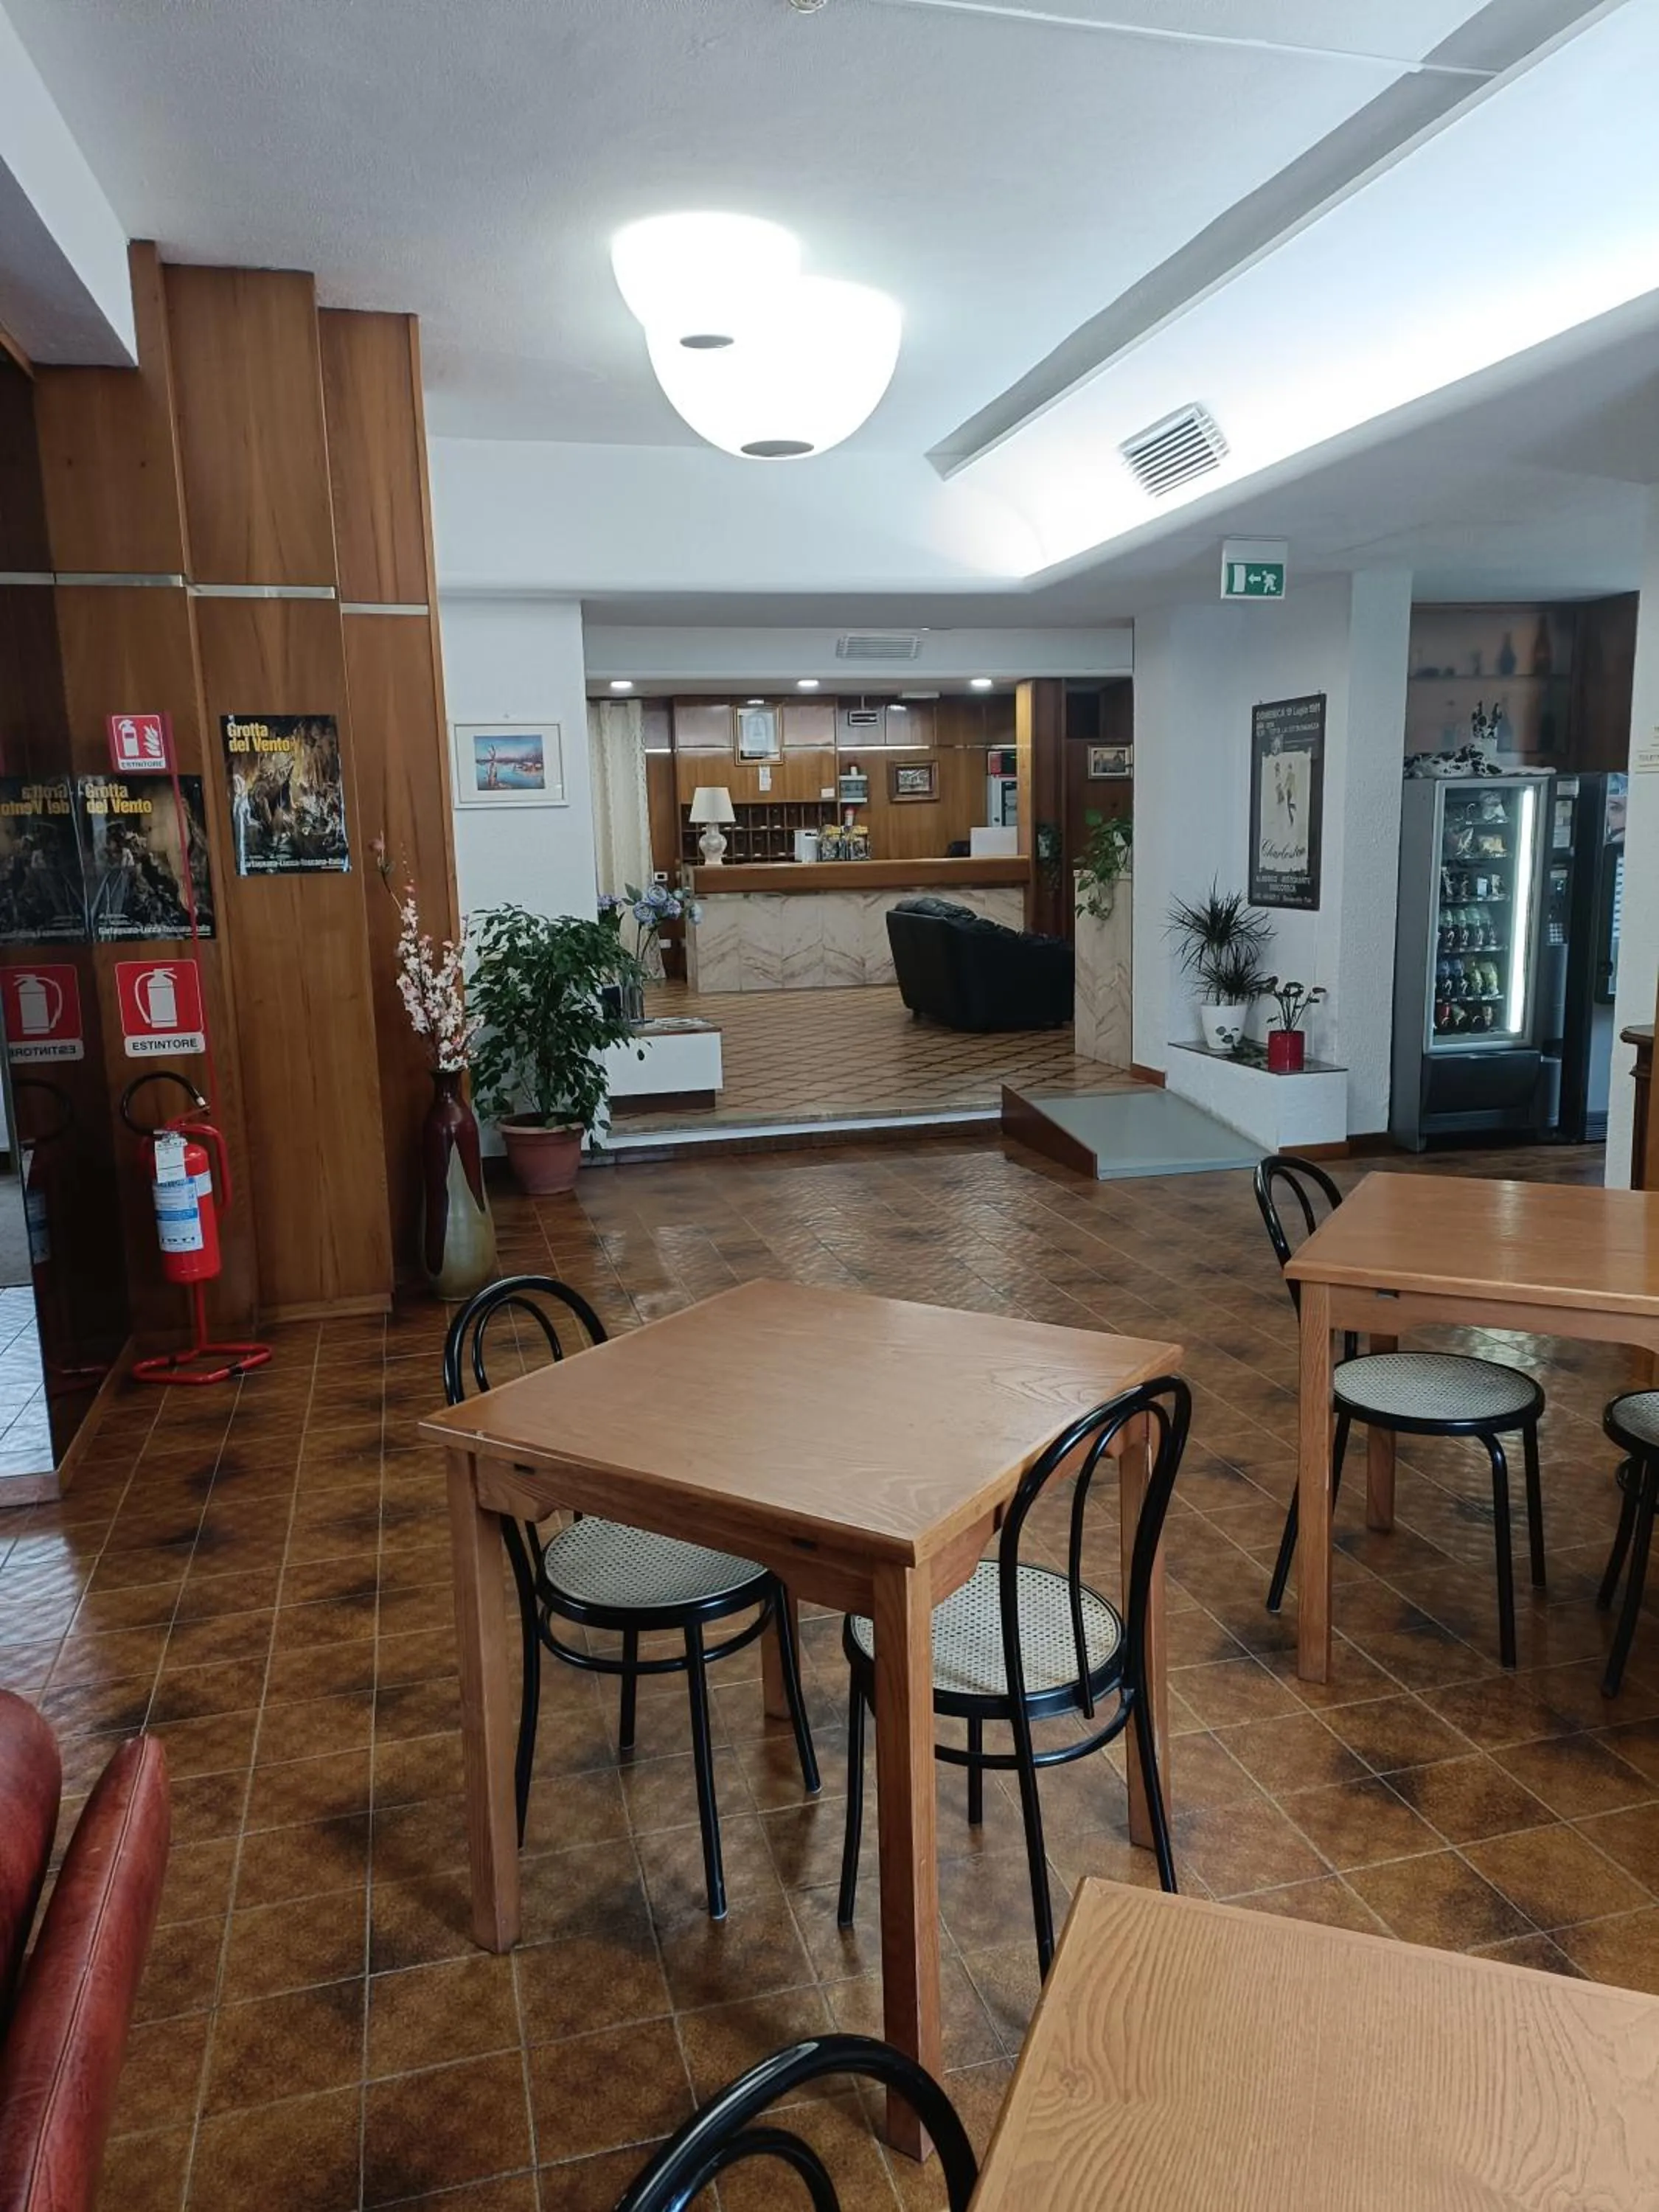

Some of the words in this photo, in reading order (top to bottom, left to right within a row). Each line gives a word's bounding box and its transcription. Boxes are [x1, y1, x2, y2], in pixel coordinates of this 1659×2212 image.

[227, 722, 268, 738] Grotta
[229, 737, 250, 752] del
[252, 737, 291, 752] Vento
[85, 783, 129, 799] Grotta
[86, 799, 108, 814] del
[111, 798, 152, 814] Vento
[132, 1037, 198, 1051] ESTINTORE
